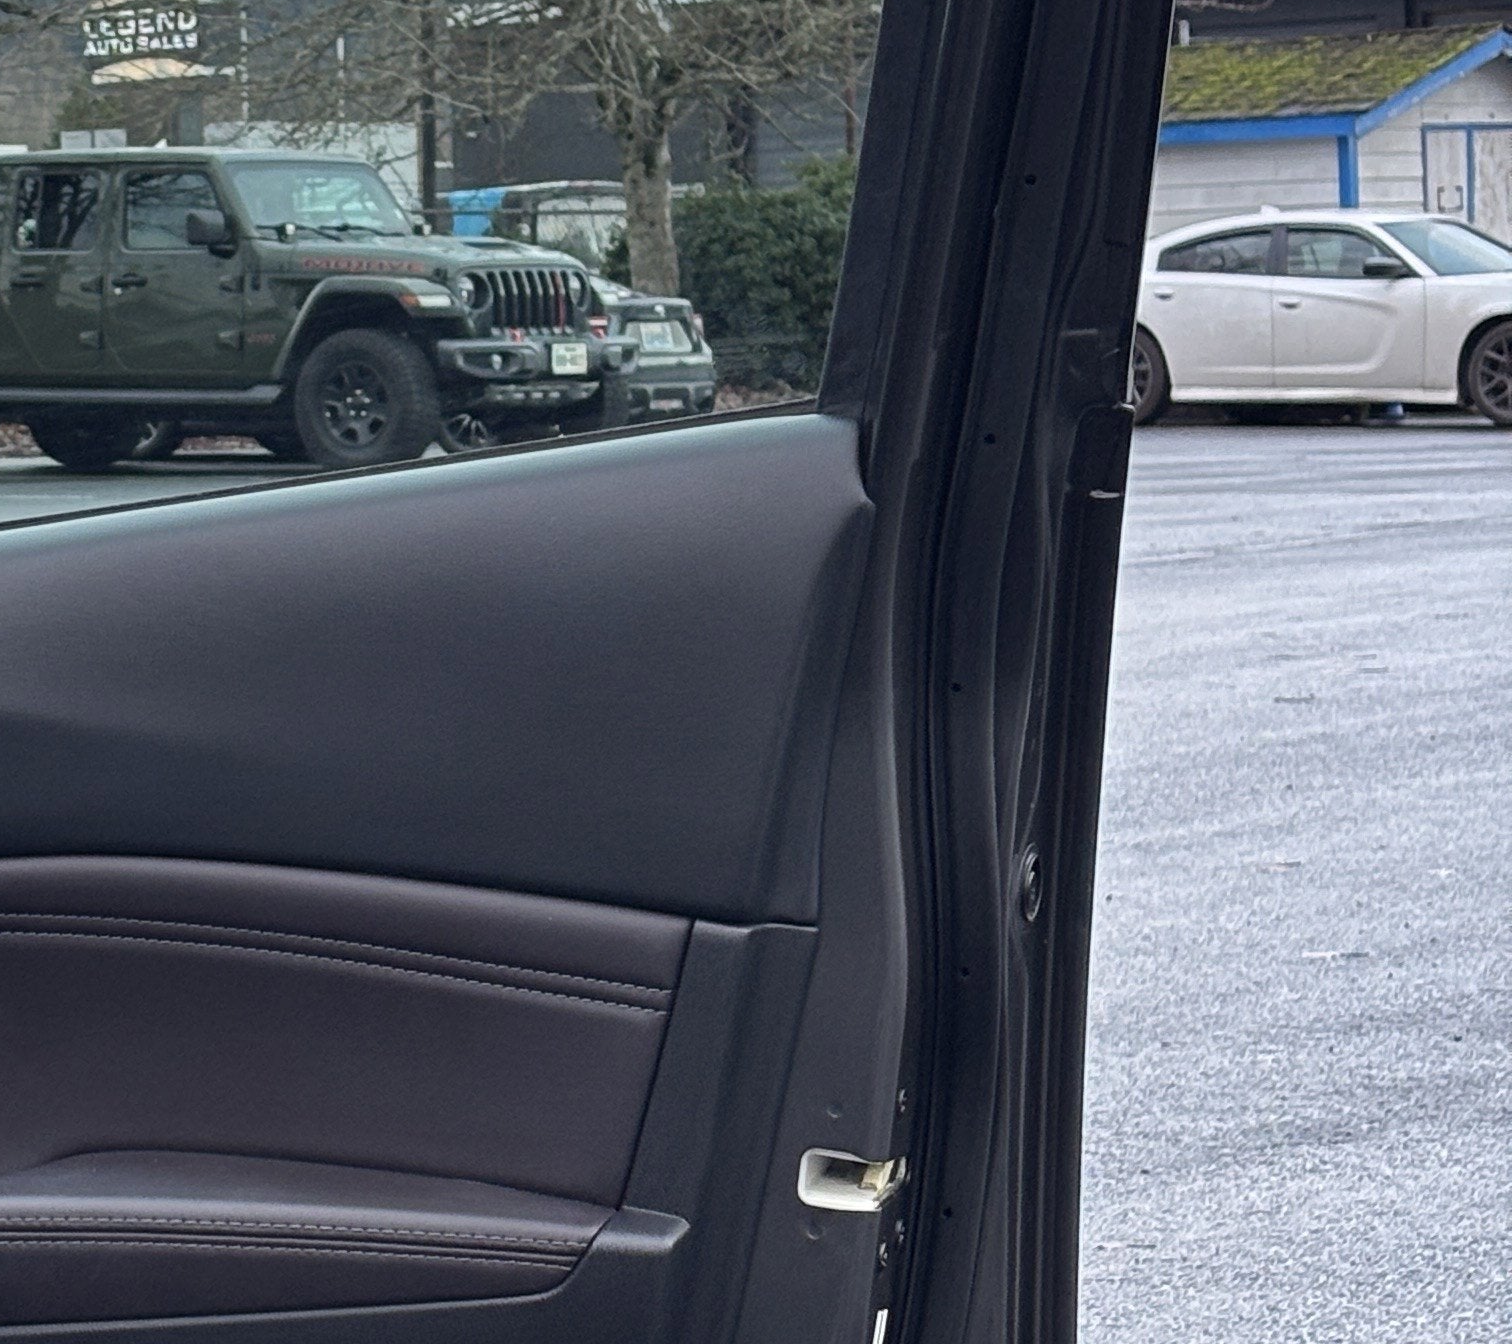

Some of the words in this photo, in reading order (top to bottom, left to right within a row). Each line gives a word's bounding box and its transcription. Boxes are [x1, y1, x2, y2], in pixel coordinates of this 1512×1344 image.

[82, 8, 198, 39] LEGEND
[83, 37, 134, 56] AUTO
[135, 32, 198, 52] SALES
